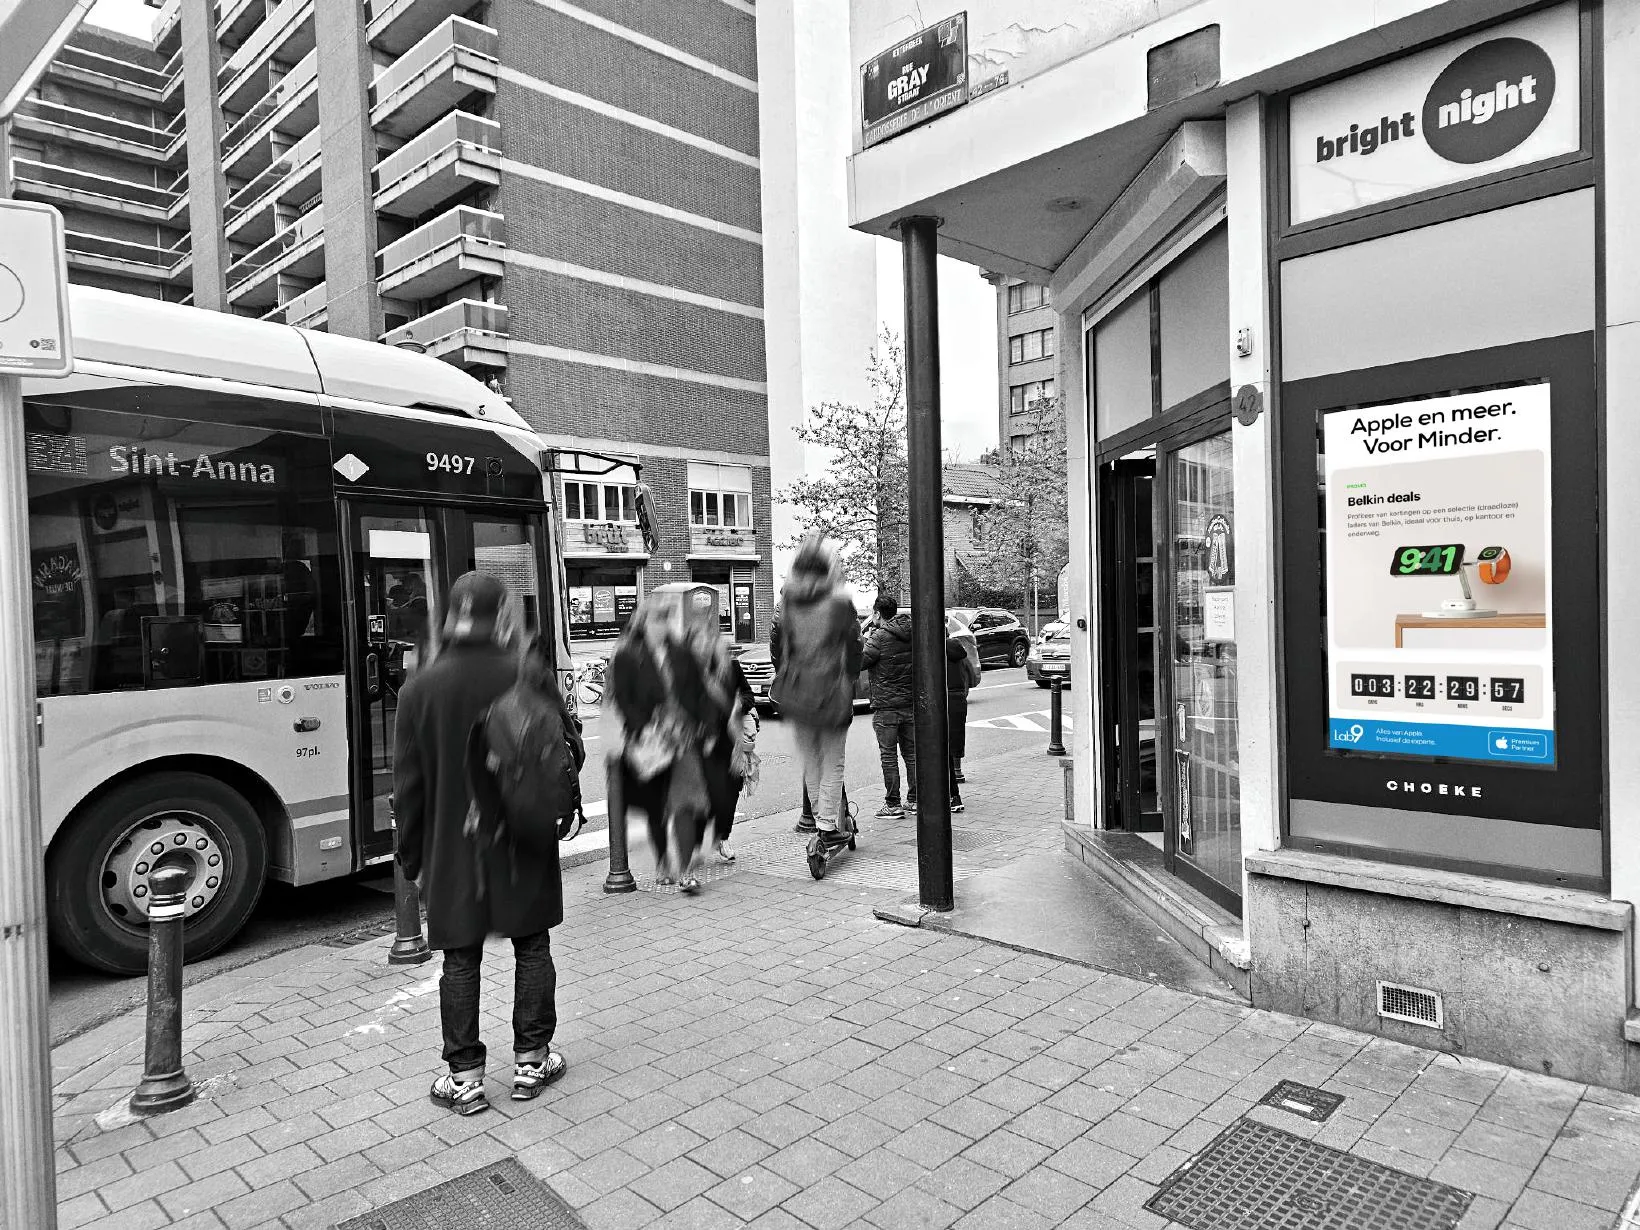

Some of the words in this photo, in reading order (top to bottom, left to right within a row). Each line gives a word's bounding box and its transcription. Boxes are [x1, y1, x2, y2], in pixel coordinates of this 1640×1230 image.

[887, 64, 930, 101] GRAY
[897, 87, 920, 105] STRAAT
[1316, 111, 1415, 163] bright
[1438, 74, 1537, 129] night
[1239, 394, 1257, 412] 42
[1350, 413, 1413, 437] Apple
[1418, 411, 1444, 426] en
[1451, 401, 1517, 422] meer.
[1362, 437, 1413, 455] Voor
[1418, 426, 1502, 449] Minder.
[109, 445, 276, 484] Sint-Anna
[426, 452, 475, 475] 9497
[1347, 494, 1385, 507] Belkin
[1386, 491, 1421, 503] deals
[1447, 505, 1476, 513] selectie
[1404, 517, 1425, 526] ideaal
[1464, 515, 1474, 523] op
[1399, 546, 1457, 574] 9:41
[1354, 678, 1391, 693] 003
[1408, 679, 1432, 696] 22
[1450, 681, 1475, 697] 29
[1494, 682, 1520, 698] 57
[1511, 744, 1535, 752] Partner
[1386, 780, 1482, 798] CHOEKE
